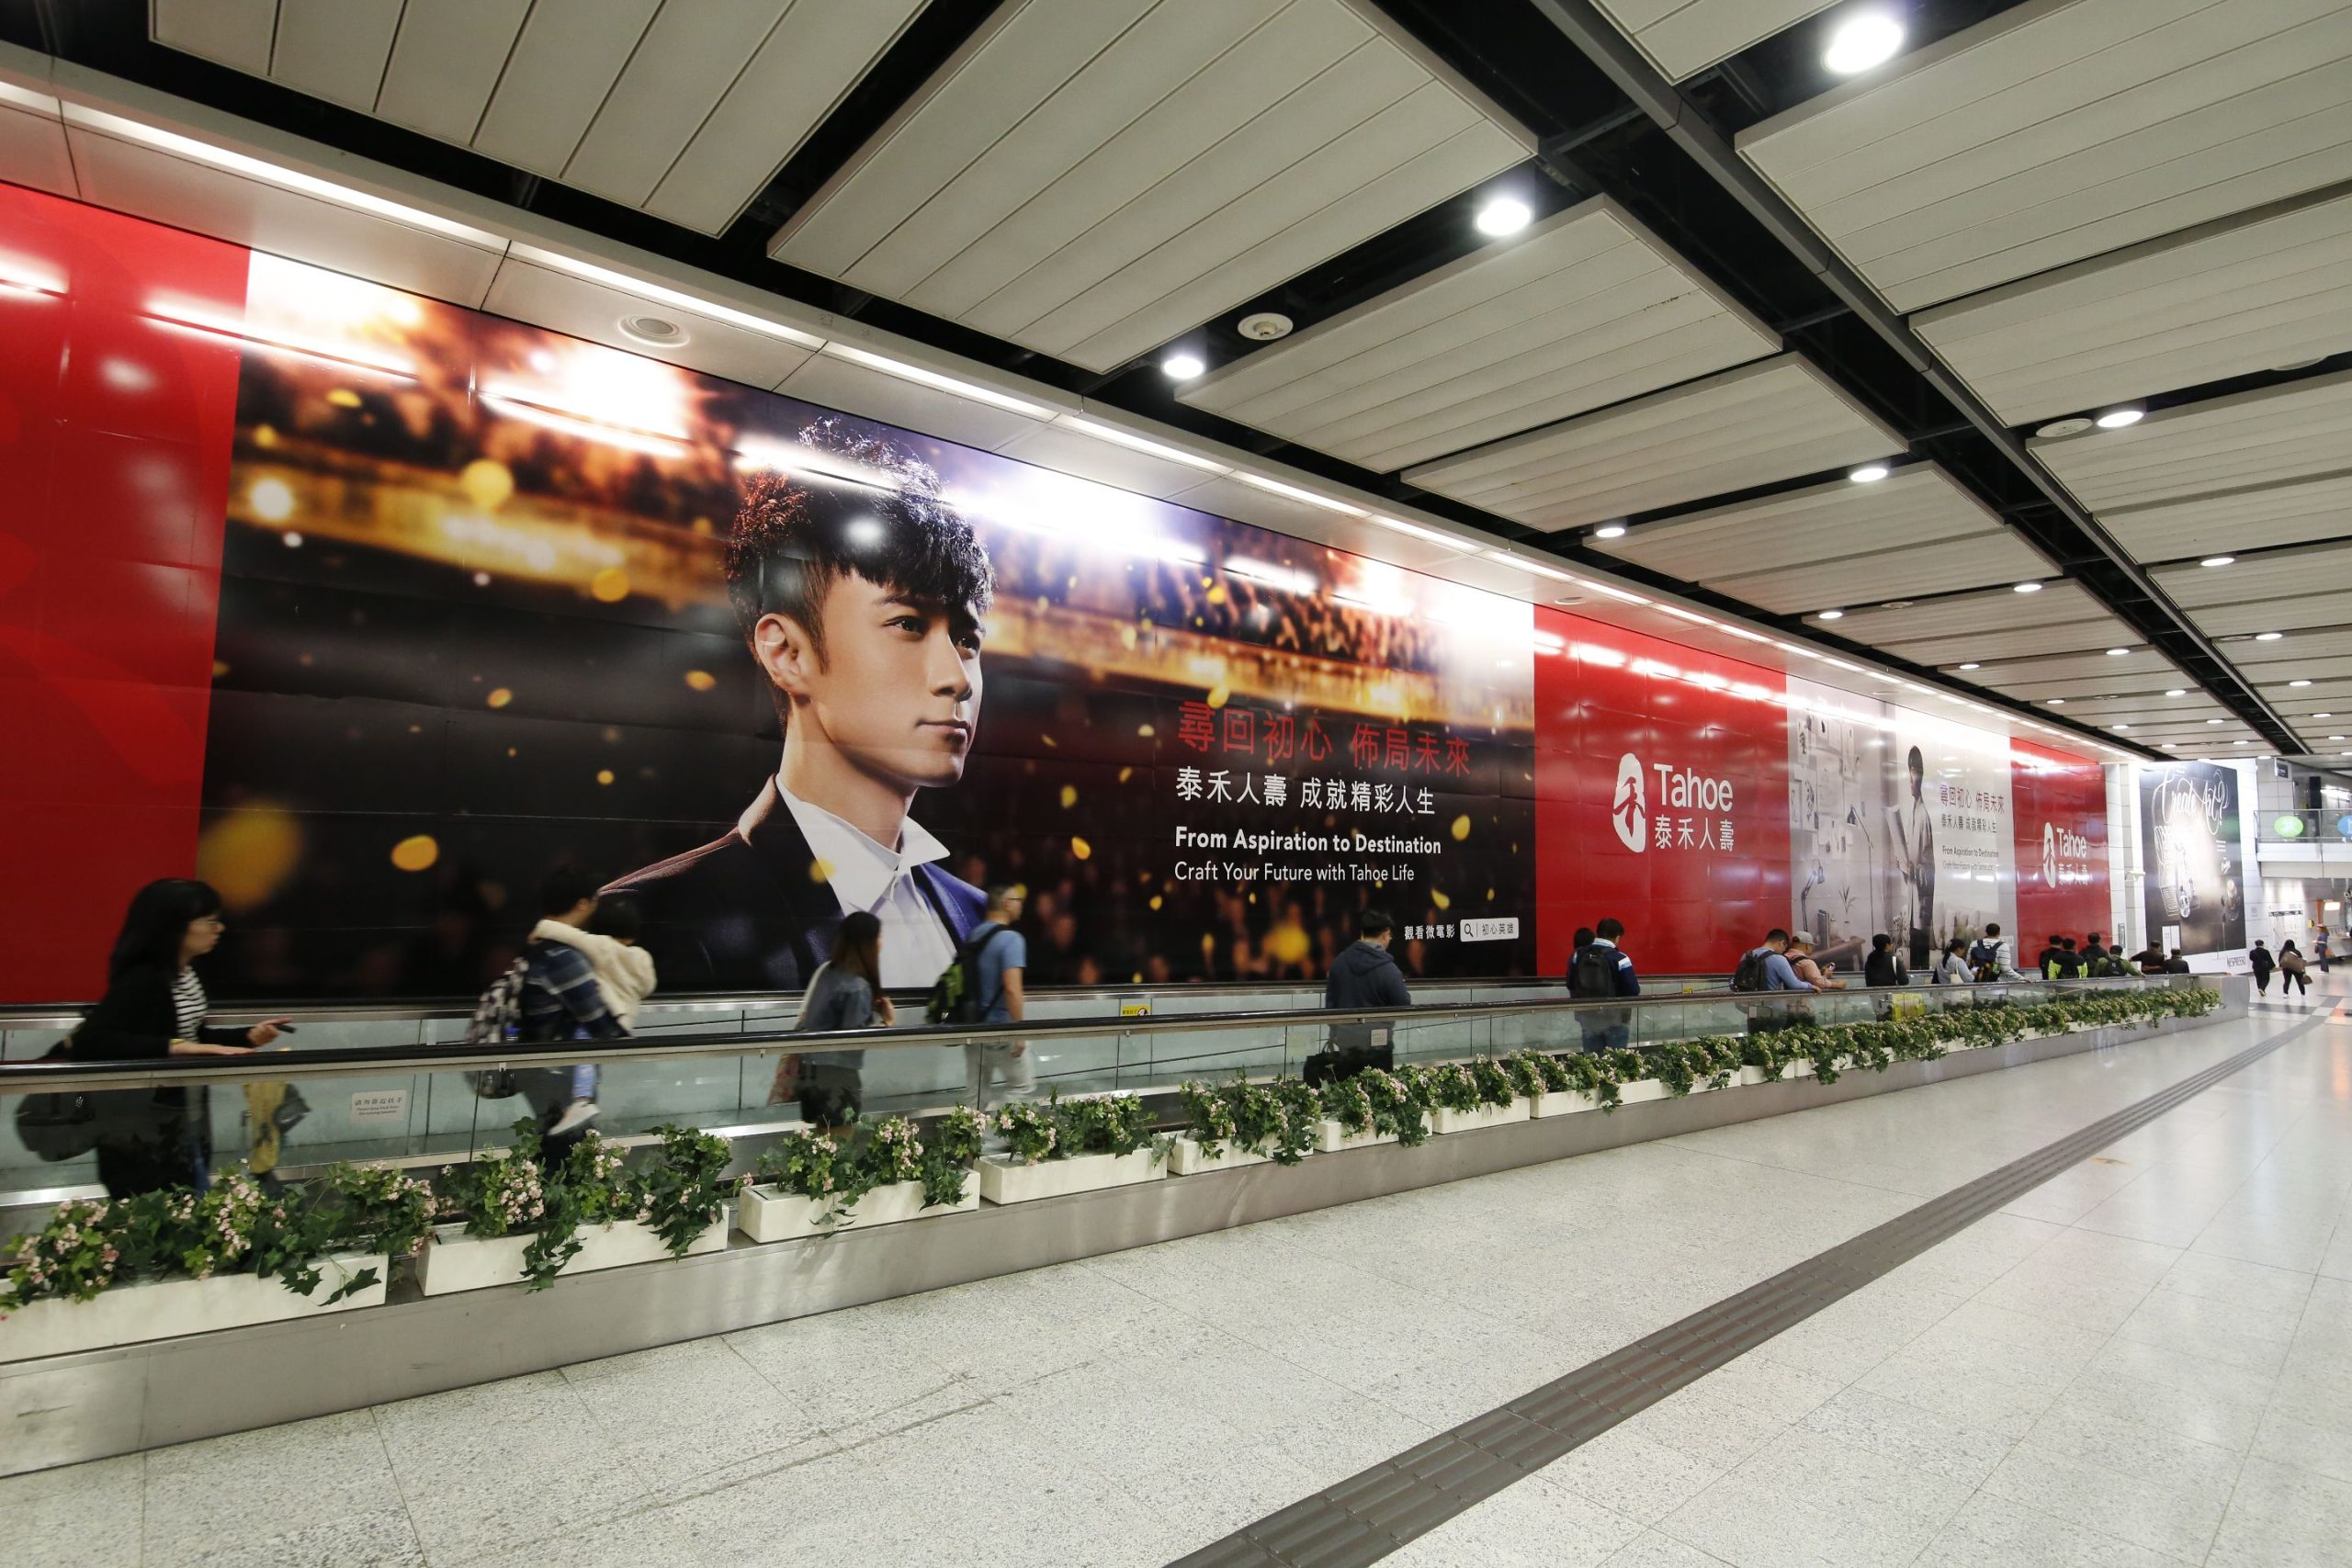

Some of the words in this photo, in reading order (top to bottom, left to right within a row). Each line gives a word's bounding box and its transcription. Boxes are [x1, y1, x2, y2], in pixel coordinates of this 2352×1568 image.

[1178, 700, 1333, 761] 尋回初心
[1351, 722, 1471, 778] 佈局未來
[1175, 765, 1287, 807] 泰禾人壽
[1300, 777, 1436, 816] 成就精彩人生
[1653, 762, 1734, 812] Tahoe
[1175, 826, 1227, 849] From
[1232, 828, 1329, 855] Aspiration
[1332, 834, 1351, 852] to
[1355, 833, 1442, 854] Destination
[1655, 814, 1735, 852] 泰禾人壽
[2056, 828, 2086, 858] Tahoe
[1174, 861, 1218, 881] Craft
[1222, 862, 1260, 881] Your
[1264, 863, 1313, 881] Future
[1316, 863, 1346, 882] with
[1349, 863, 1388, 882] Tahoe
[1392, 864, 1415, 882] Life
[1404, 924, 1455, 941] 觀看微電影
